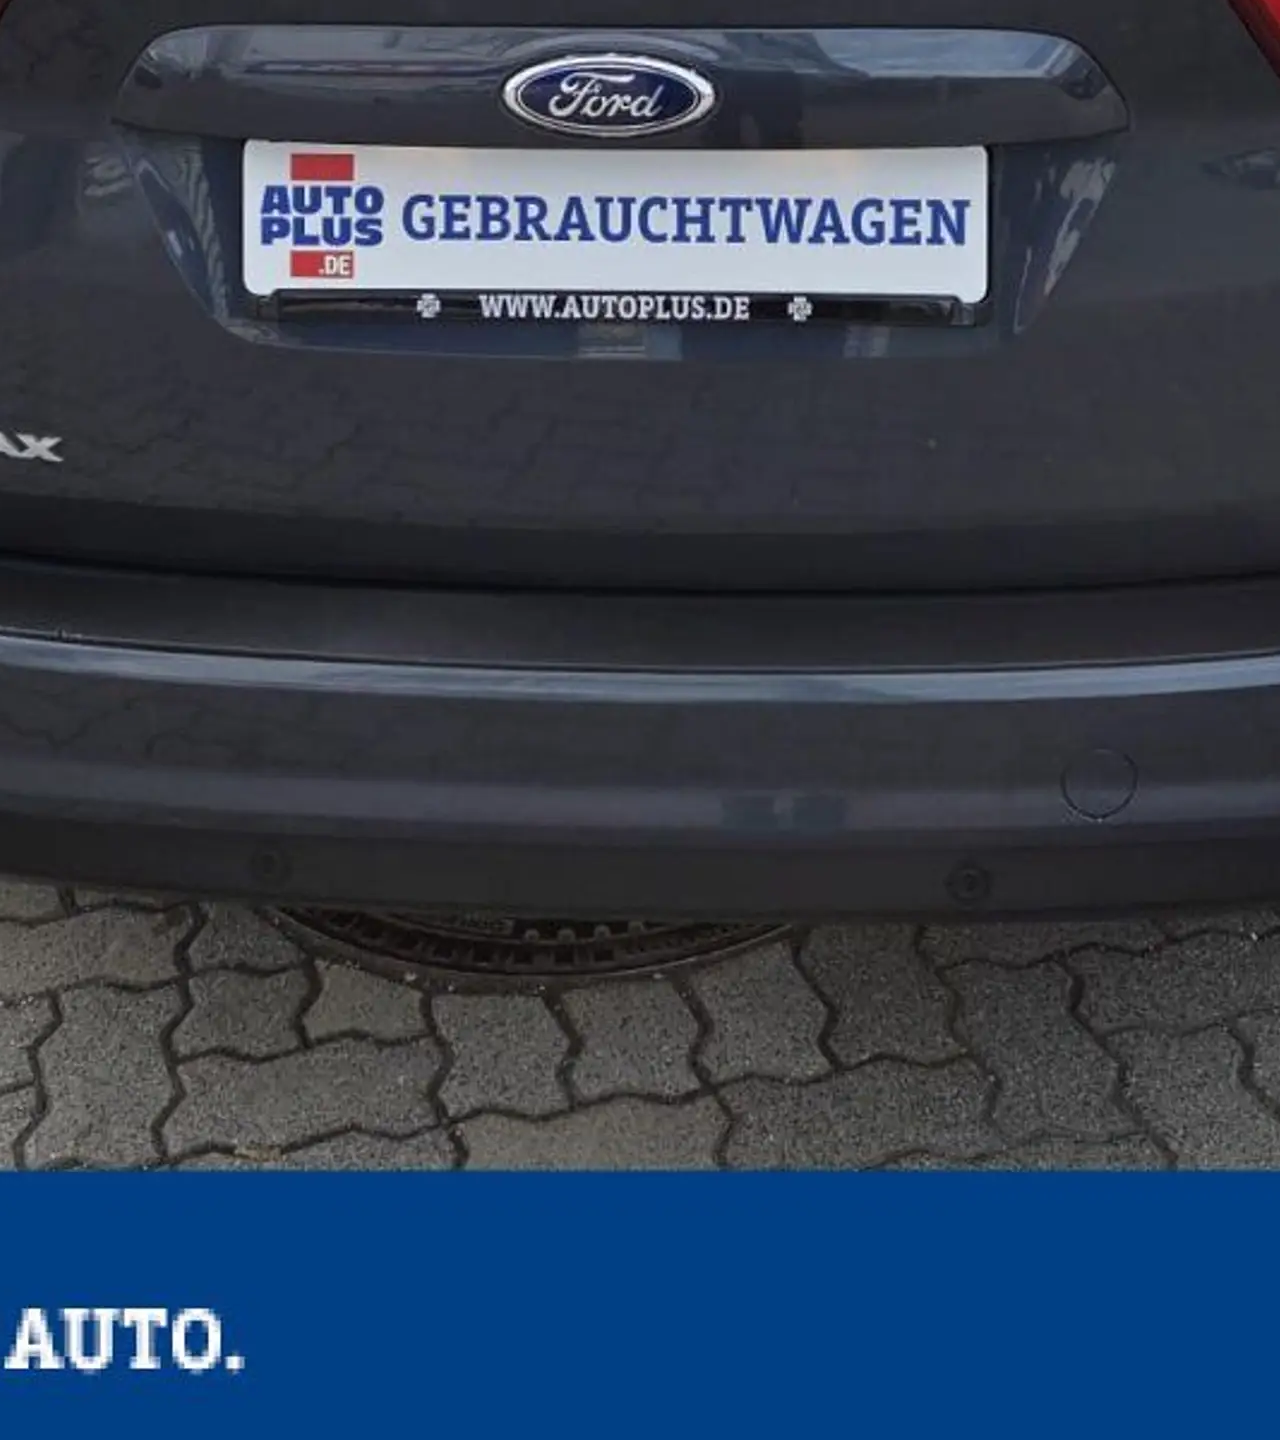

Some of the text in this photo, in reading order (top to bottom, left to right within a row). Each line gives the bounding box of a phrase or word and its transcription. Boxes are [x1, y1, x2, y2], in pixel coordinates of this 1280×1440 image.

[548, 69, 663, 120] Ford
[261, 184, 385, 215] AUTO
[261, 216, 384, 247] PLUS
[402, 194, 971, 246] GEBRAUCHTWAGEN
[318, 255, 351, 275] .DE
[479, 294, 750, 321] WWW.AUTOPLUS.DE
